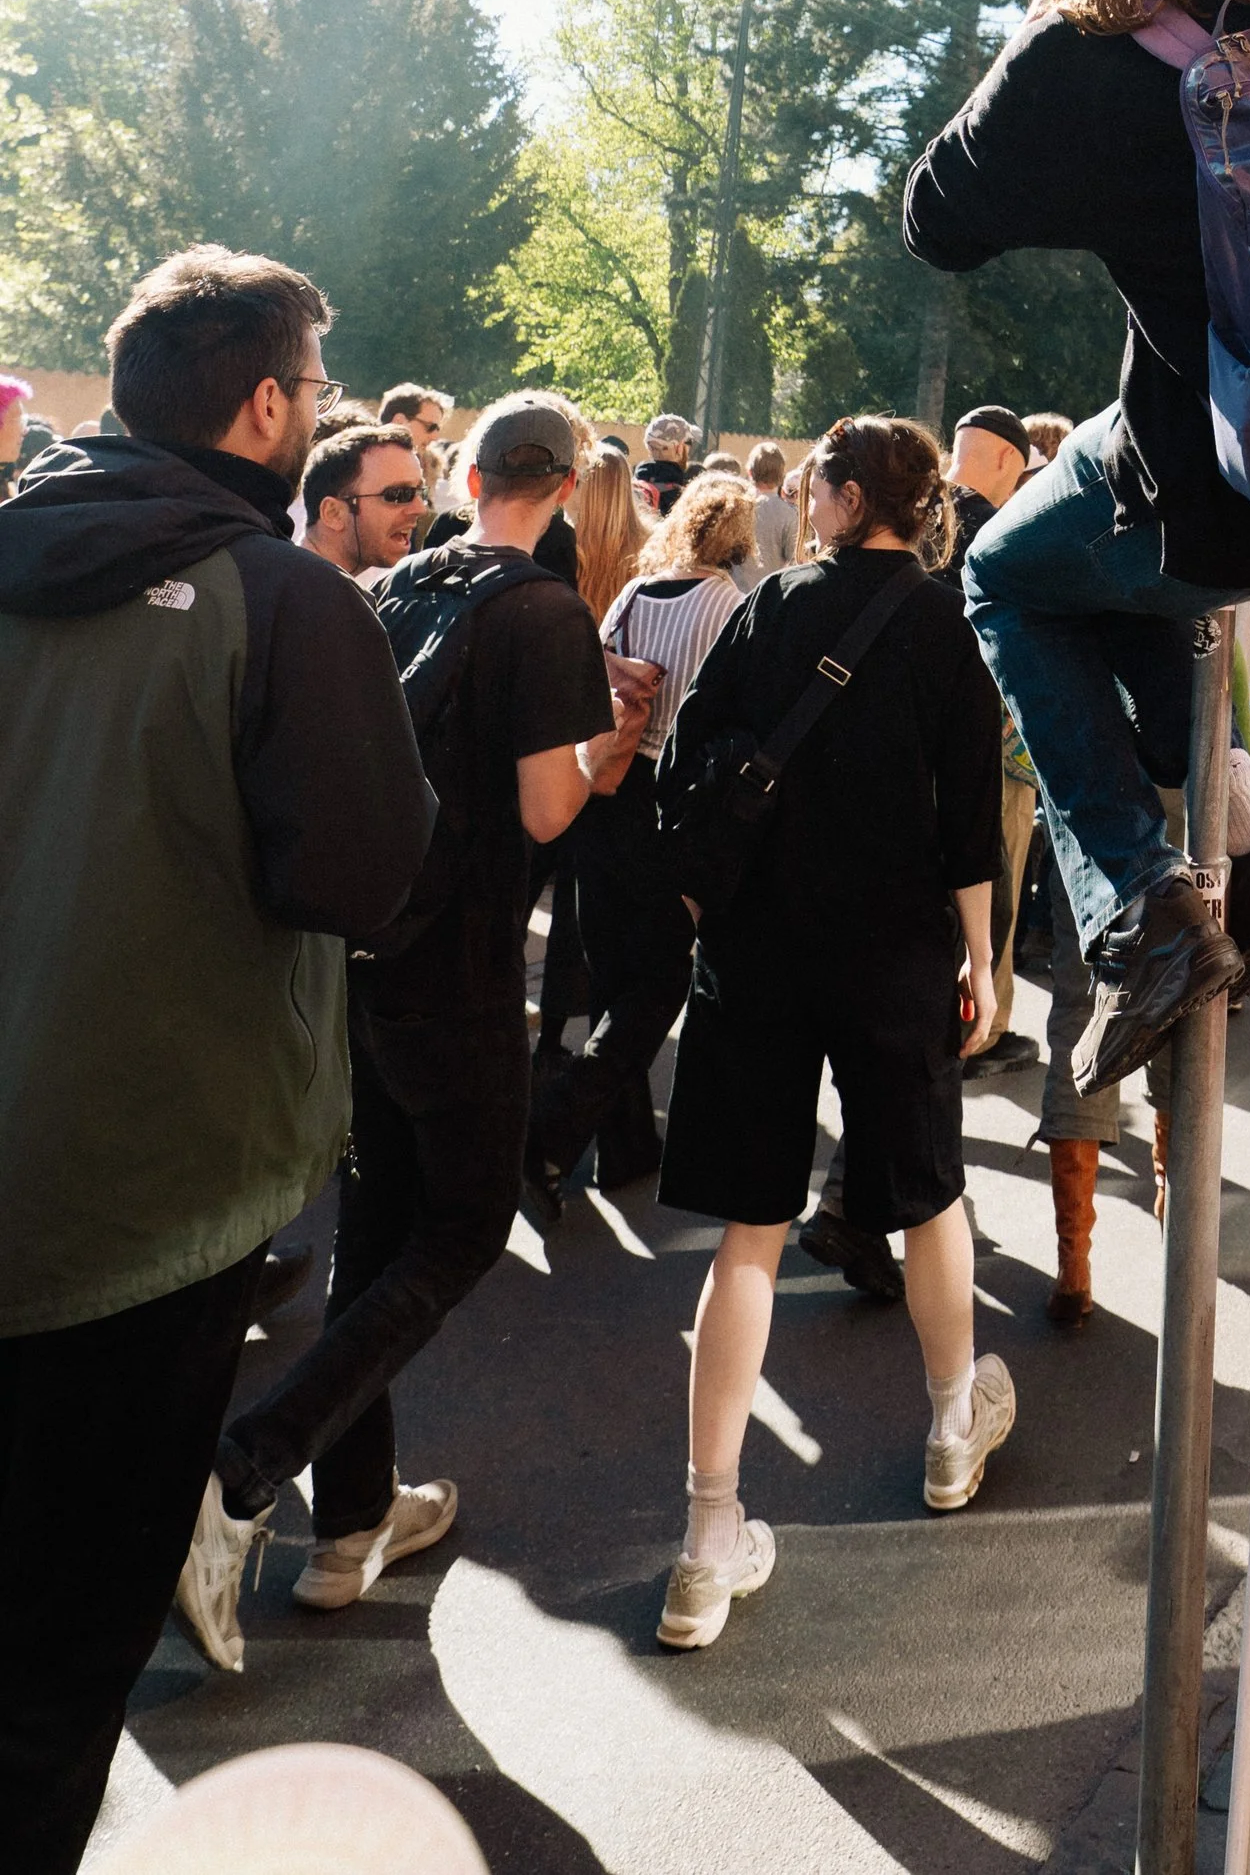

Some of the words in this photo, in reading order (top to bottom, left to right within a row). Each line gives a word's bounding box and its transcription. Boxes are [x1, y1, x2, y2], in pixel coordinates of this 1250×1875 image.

[164, 580, 184, 591] THE
[143, 587, 179, 599] NORTH
[147, 596, 174, 607] FACE
